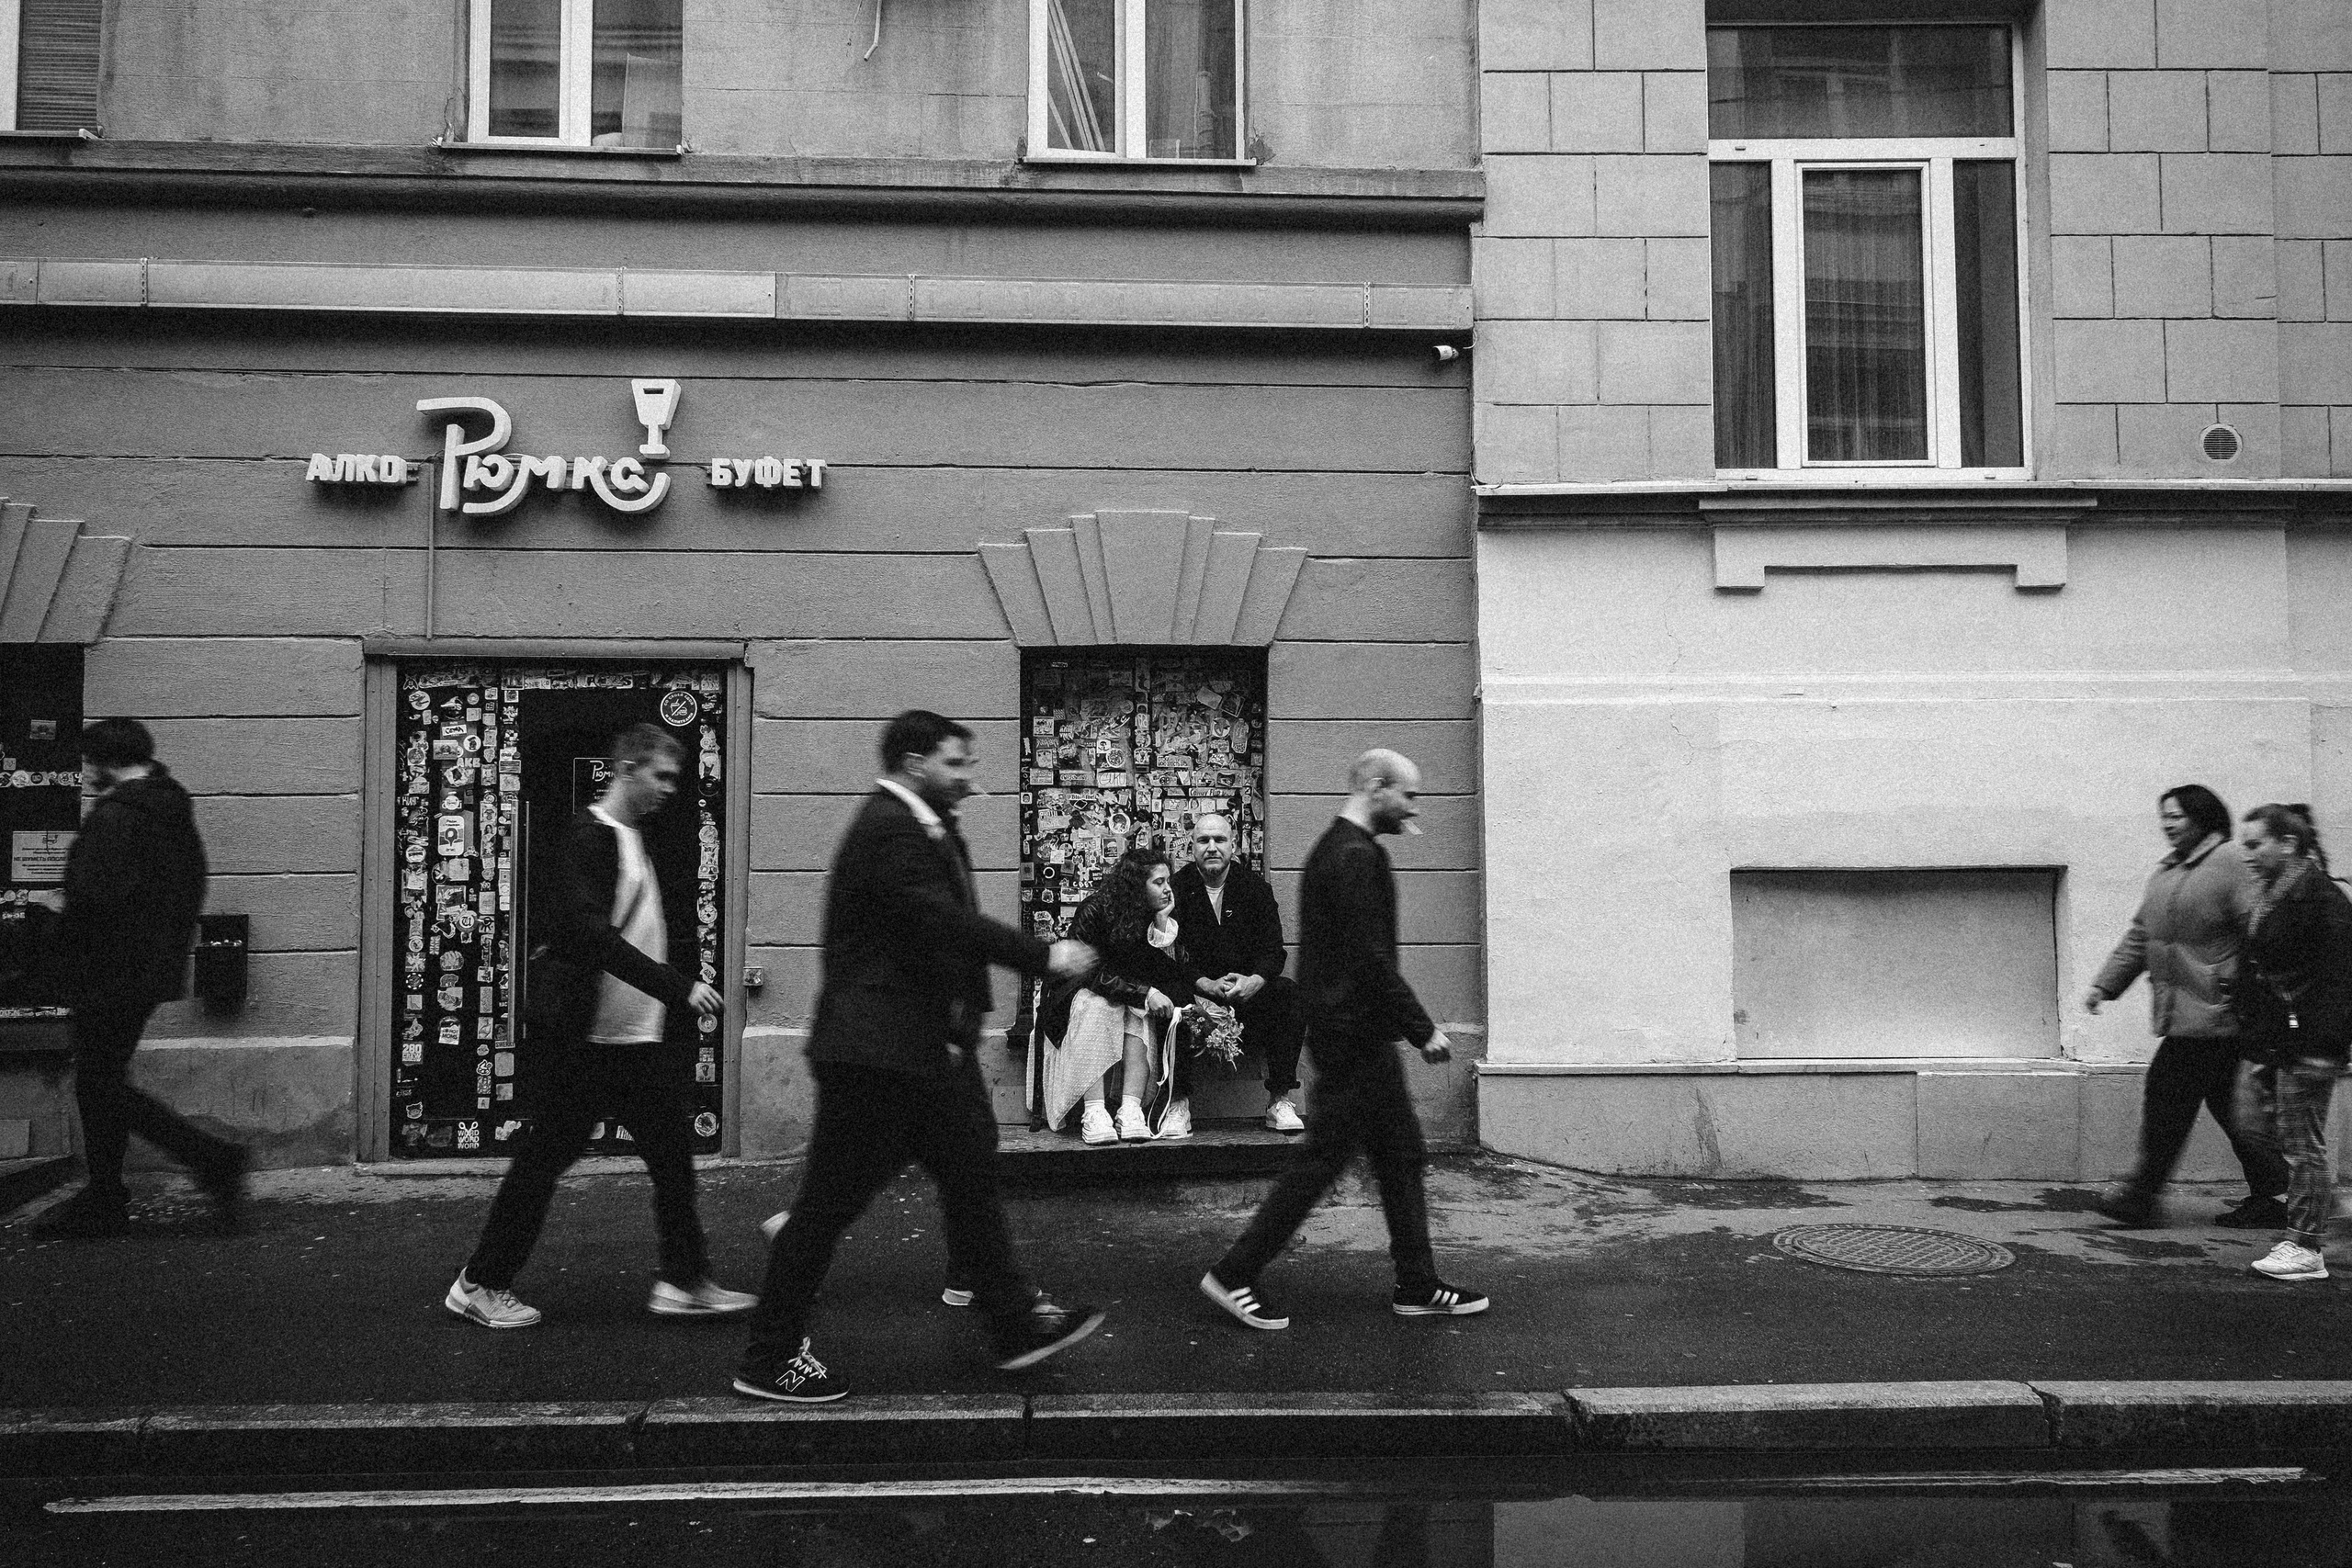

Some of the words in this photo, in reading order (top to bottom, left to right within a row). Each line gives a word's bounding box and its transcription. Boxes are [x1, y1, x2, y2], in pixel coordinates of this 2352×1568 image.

[306, 453, 407, 484] АЛКО
[710, 457, 826, 489] БУФЕТ
[402, 1043, 423, 1053] 280
[775, 1370, 806, 1392] N
